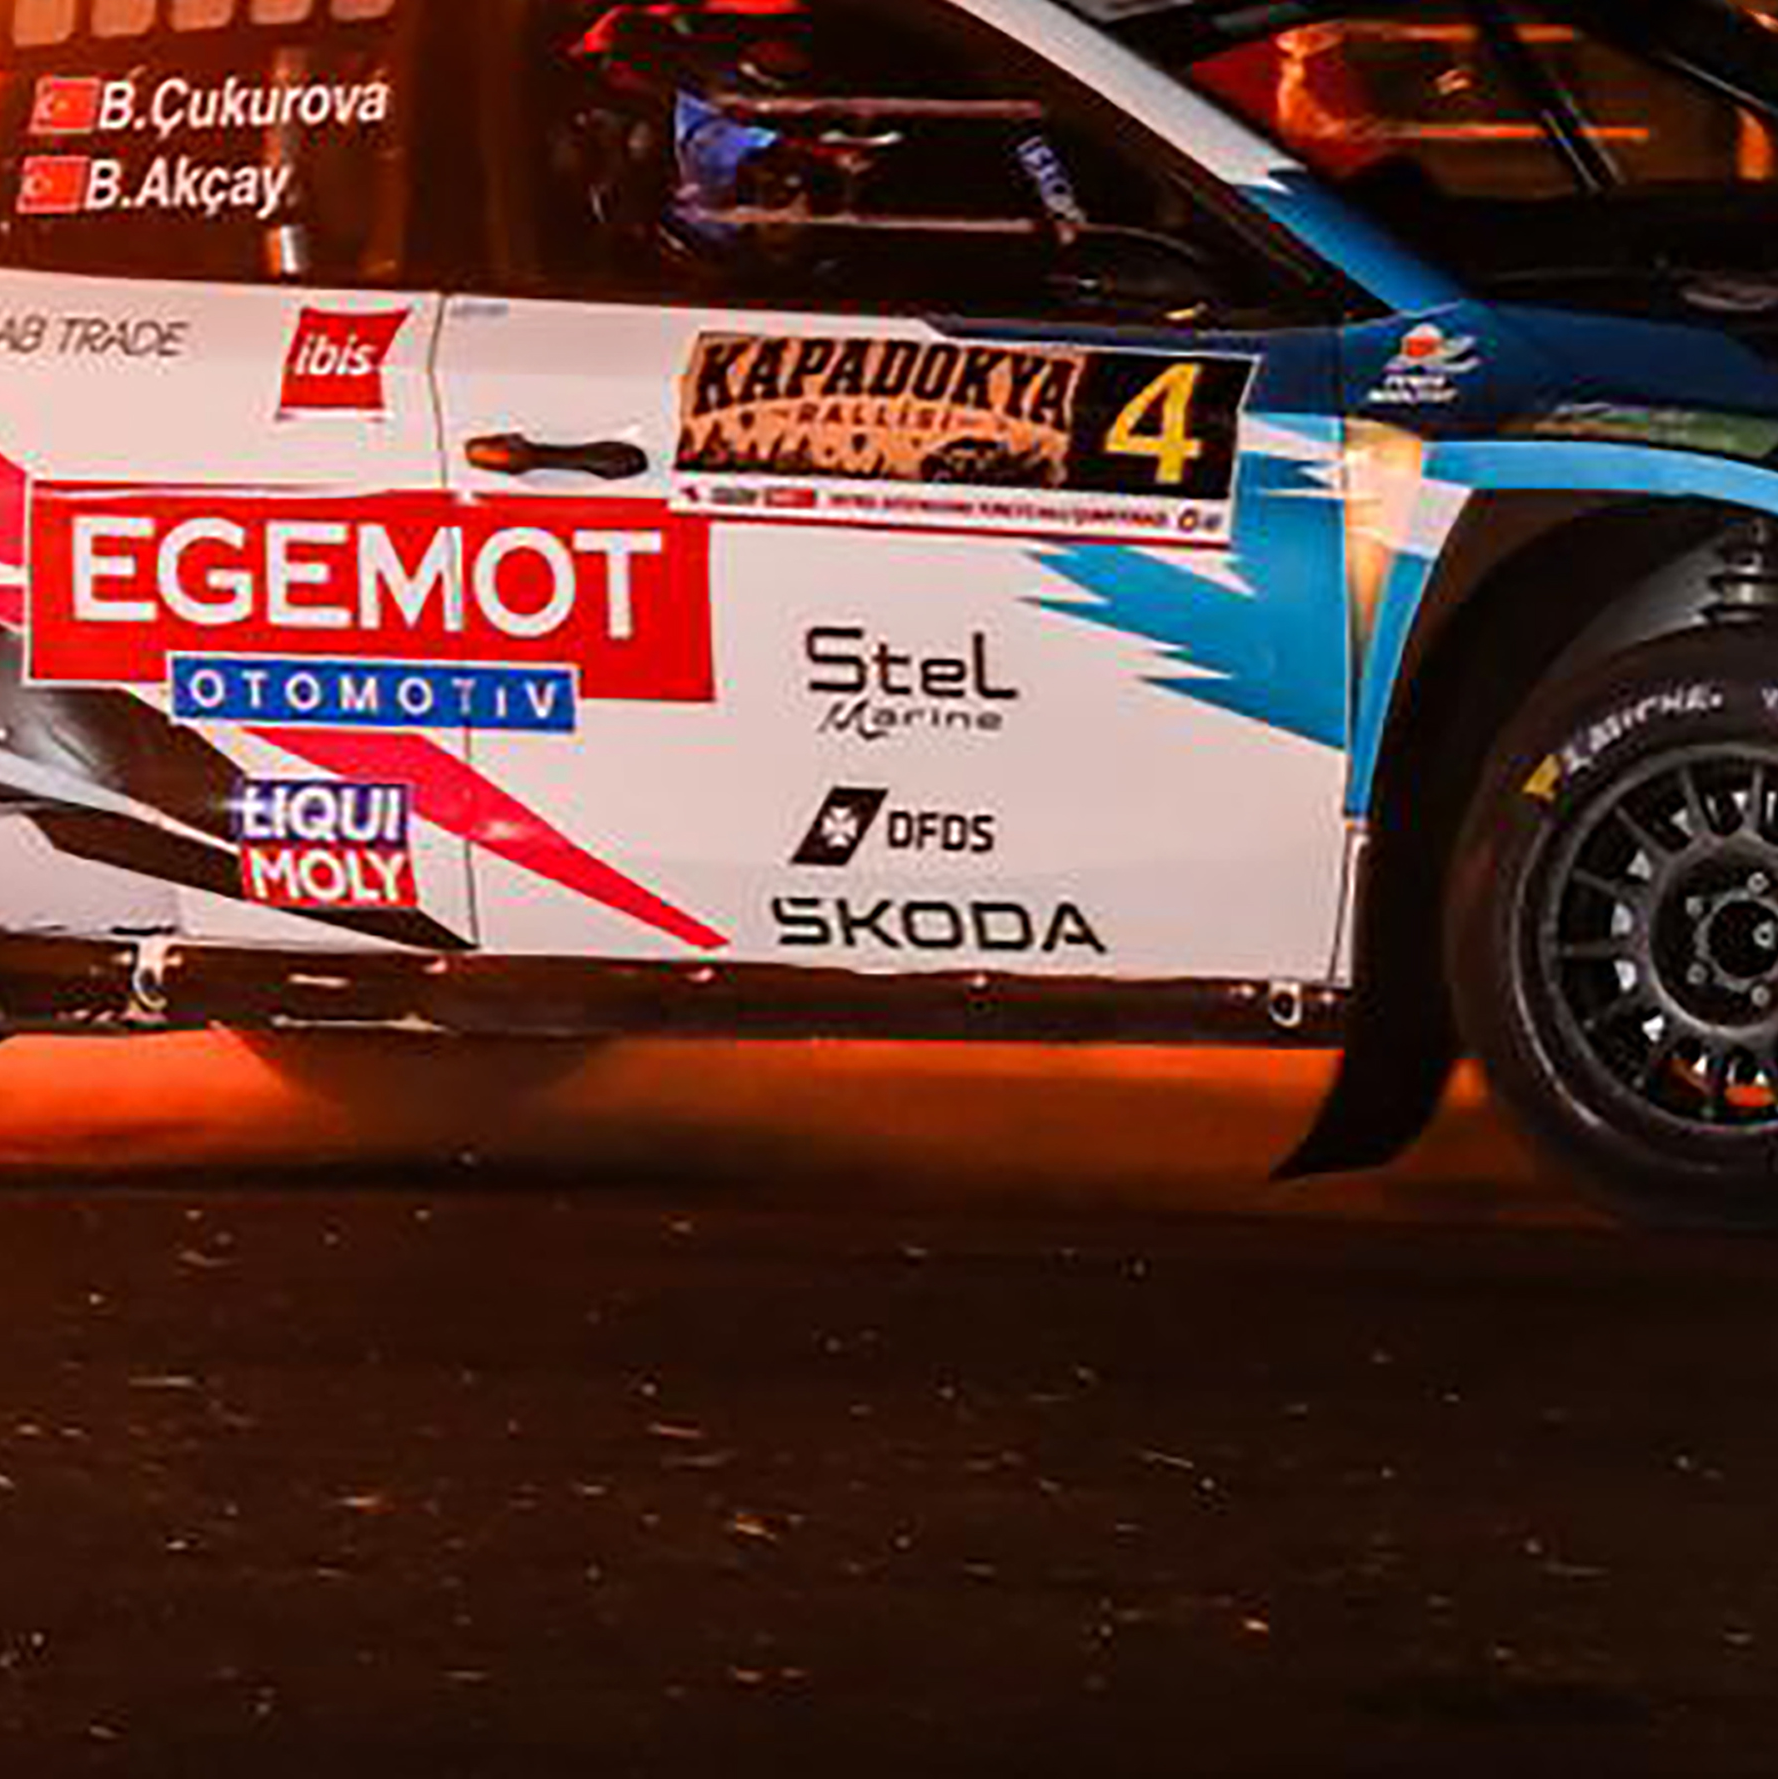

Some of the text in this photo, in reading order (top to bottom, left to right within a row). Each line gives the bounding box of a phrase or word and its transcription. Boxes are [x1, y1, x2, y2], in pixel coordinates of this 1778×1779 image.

[98, 77, 392, 138] B.Çukurova
[84, 158, 289, 219] B.Akçay
[55, 318, 188, 356] TRADE
[292, 332, 379, 376] ibis
[692, 338, 1076, 431] KAPADOKYA
[1105, 363, 1201, 483] 4
[71, 516, 663, 639] EGEMOT
[817, 699, 1004, 741] Marine
[242, 784, 402, 841] LIQUI
[887, 811, 995, 852] DFDS
[249, 847, 406, 902] MOLY
